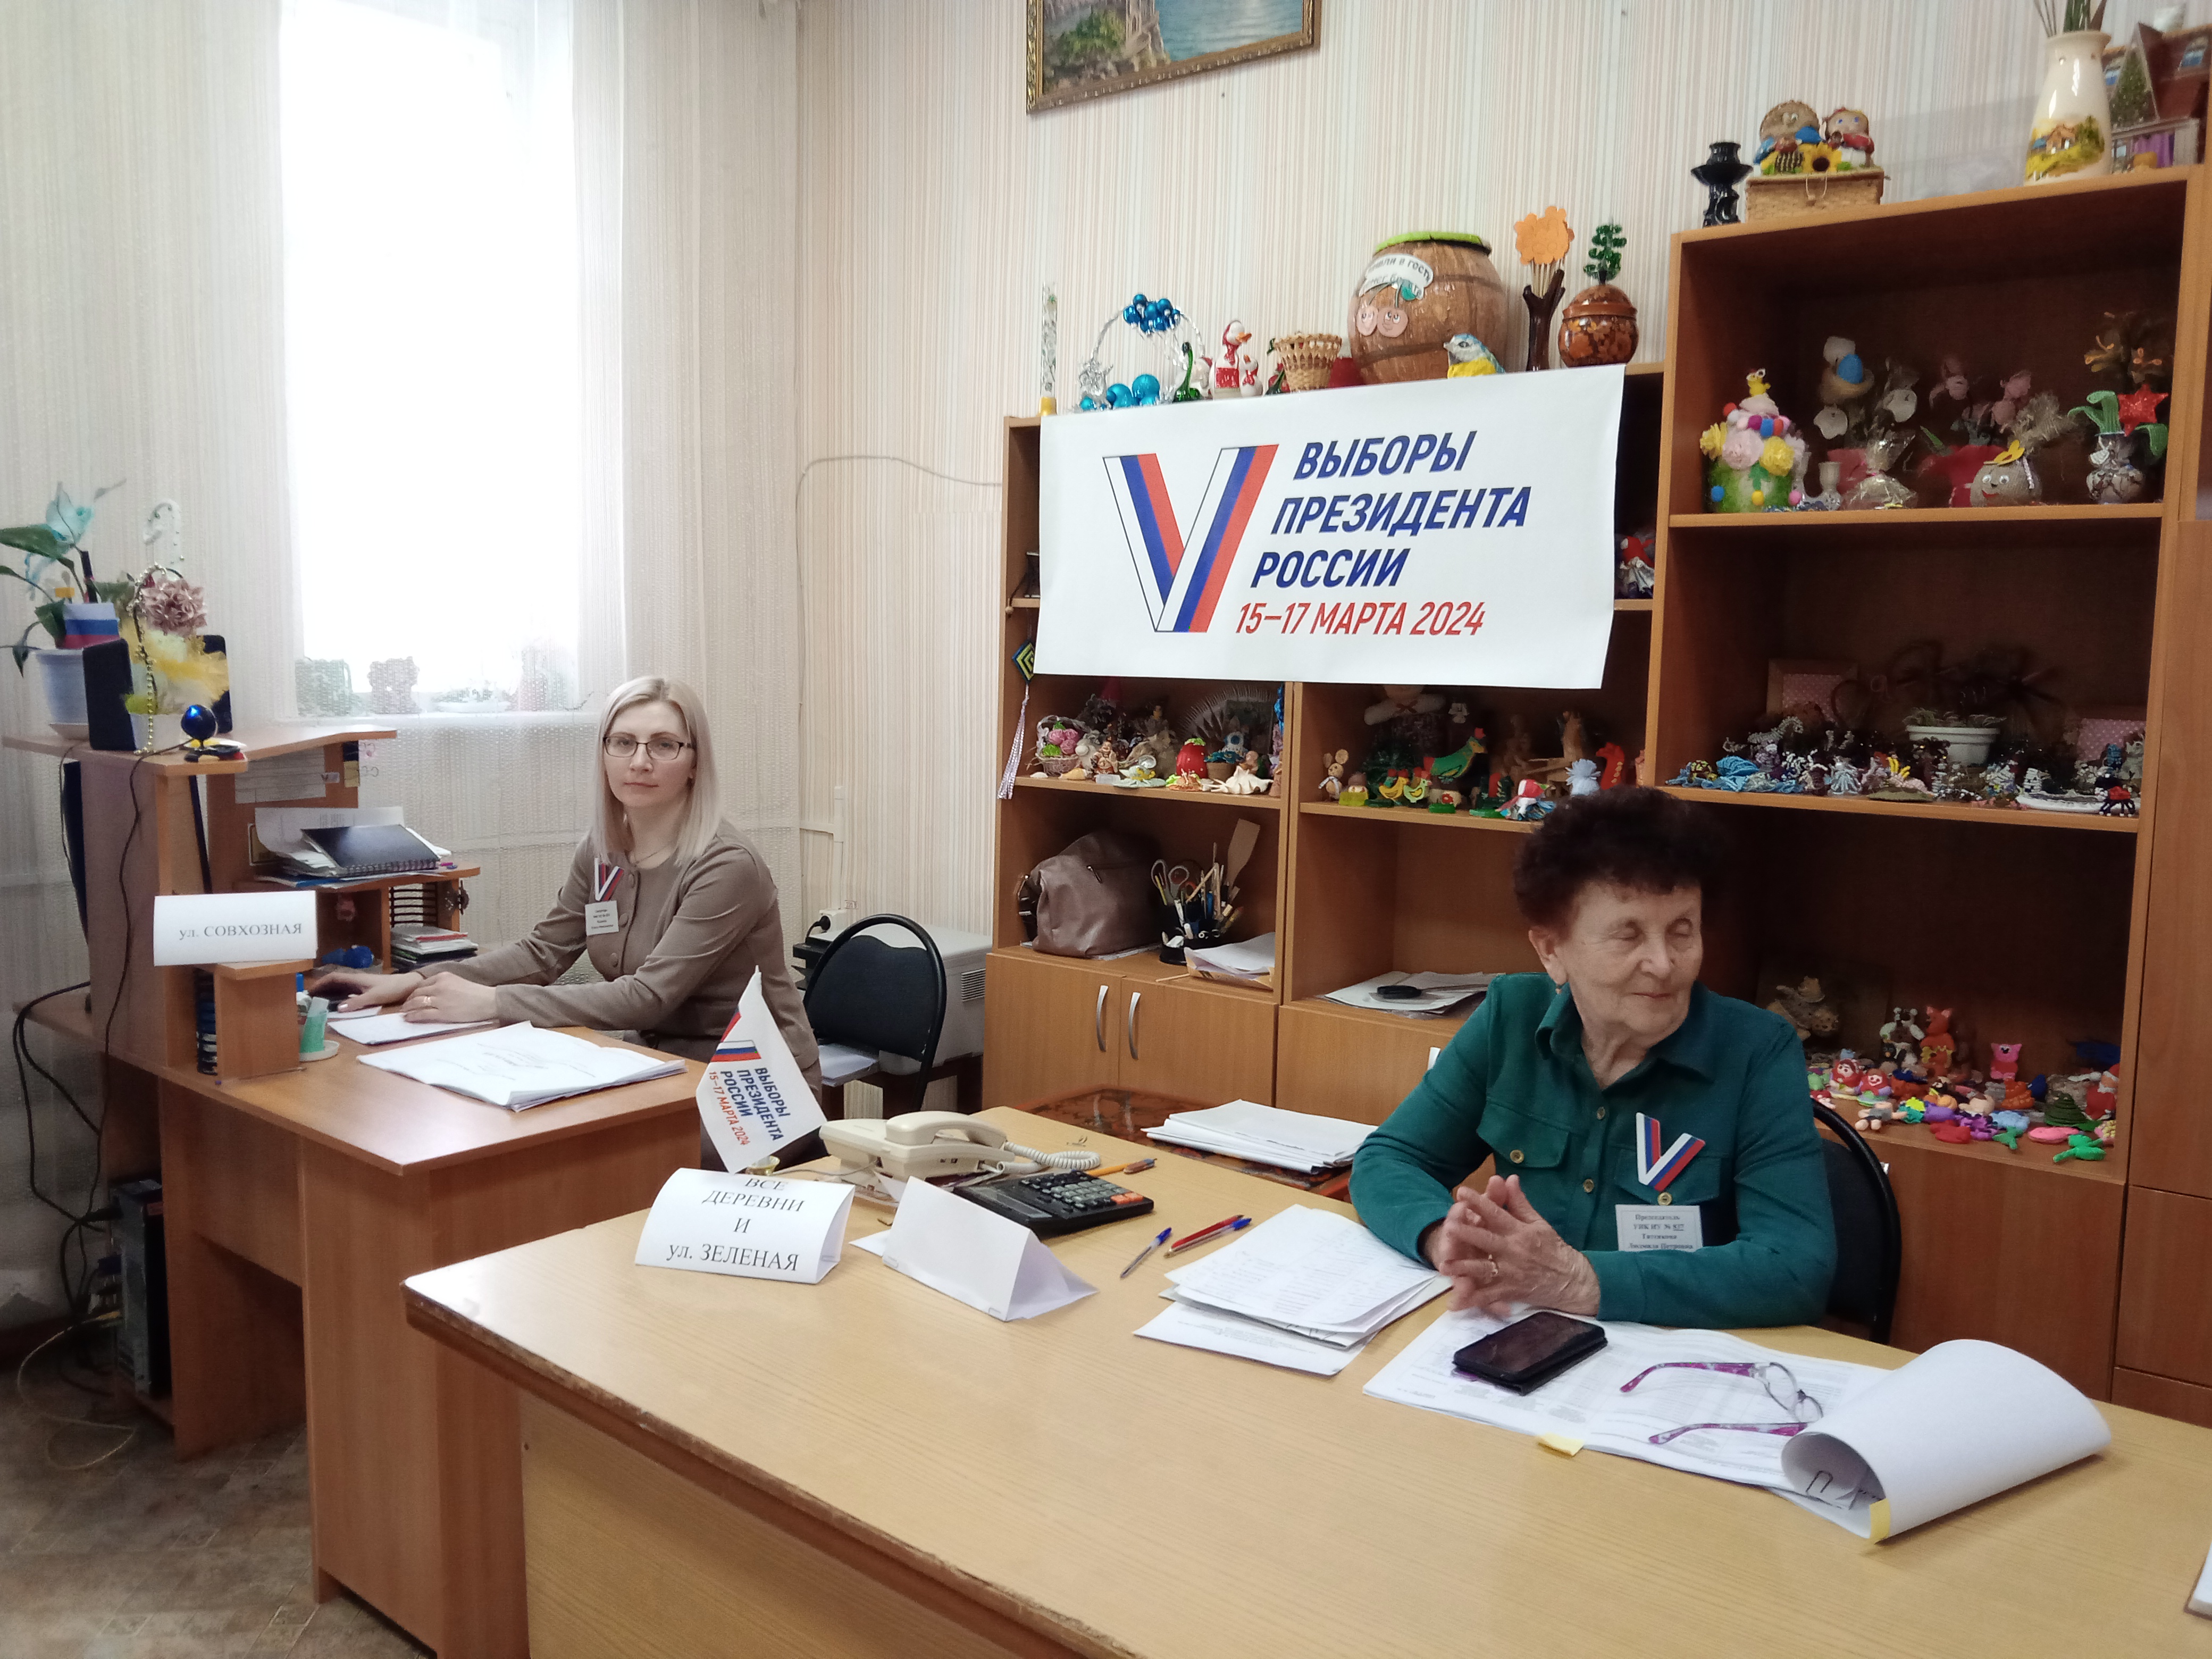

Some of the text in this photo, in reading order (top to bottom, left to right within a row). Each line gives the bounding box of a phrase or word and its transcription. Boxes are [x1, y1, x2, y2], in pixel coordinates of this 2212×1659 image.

[1294, 431, 1476, 481] ВЫБОРЫ
[1271, 487, 1531, 537] ПРЕЗИДЕНТА
[1251, 548, 1410, 589] РОССИИ
[1312, 601, 1408, 635] МАРТА
[1410, 601, 1486, 636] 2024
[179, 923, 302, 940] ул. СОВХОЗНАЯ
[720, 1071, 753, 1117] РОССИИ
[737, 1070, 784, 1142] ПРЕЗИДЕНТА
[755, 1067, 791, 1117] ВЫБОРЫ
[718, 1097, 736, 1126] МАРТА
[731, 1126, 751, 1145] 2024
[702, 1190, 805, 1212] ДЕРЕВНИ
[744, 1177, 788, 1191] ВСЕ
[733, 1218, 751, 1234] И
[666, 1243, 800, 1271] ул. ЗЕЛЕНАЯ
